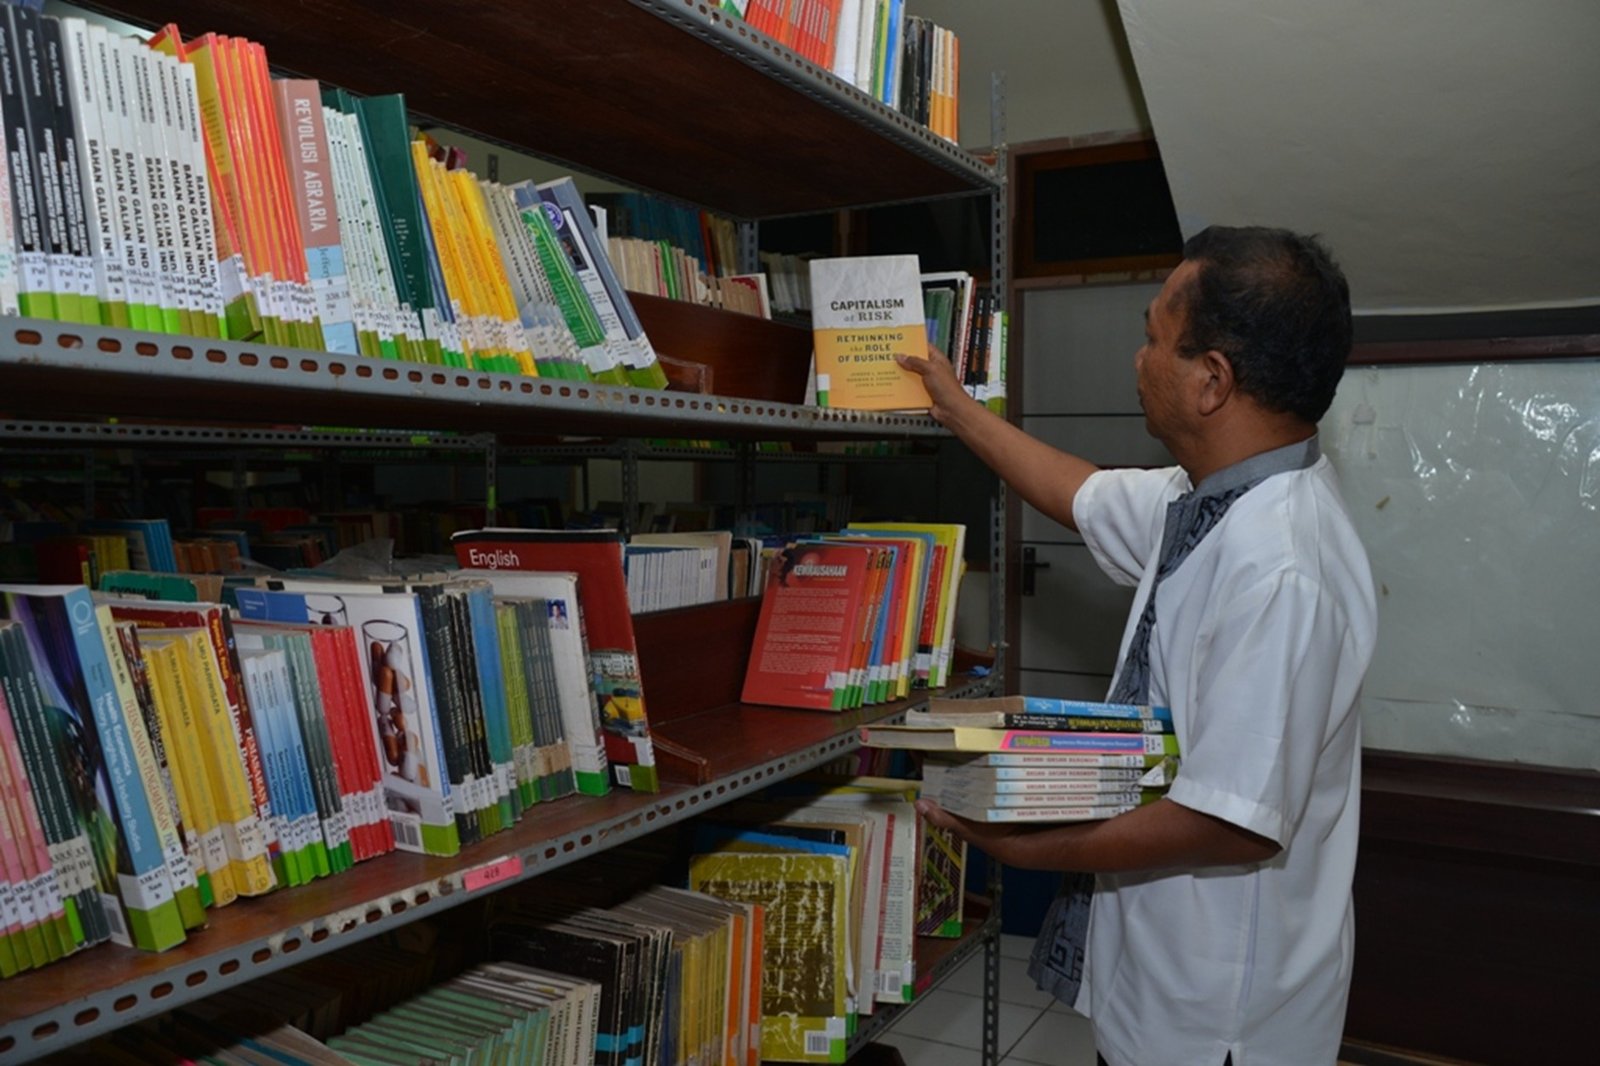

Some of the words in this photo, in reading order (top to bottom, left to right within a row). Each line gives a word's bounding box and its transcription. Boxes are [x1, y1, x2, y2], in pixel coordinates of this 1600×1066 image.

[293, 98, 318, 163] REVOLUSI
[89, 139, 103, 183] BAHAN
[170, 160, 183, 201] BAHAN
[95, 187, 111, 234] GALIAN
[111, 148, 125, 191] BAHAN
[118, 195, 132, 242] GALIAN
[125, 152, 138, 195] BAHAN
[132, 198, 146, 245] GALIAN
[145, 157, 158, 200] BAHAN
[152, 203, 166, 249] GALIAN
[183, 164, 196, 205] BAHAN
[190, 208, 203, 251] GALIAN
[303, 170, 328, 233] AGRARIA
[176, 204, 191, 249] GALIAN
[830, 298, 905, 311] CAPITALISM
[858, 310, 894, 322] RISK
[836, 332, 904, 343] RETHINKING
[837, 355, 850, 363] OF
[864, 343, 891, 352] ROLE
[469, 548, 520, 570] English
[202, 661, 221, 714] PARIWISATA
[105, 691, 119, 724] Health
[113, 724, 131, 776] Economics
[245, 727, 268, 802] PEMASARAN
[112, 766, 124, 785] and
[118, 785, 132, 822] Industry
[127, 819, 142, 852] Studies
